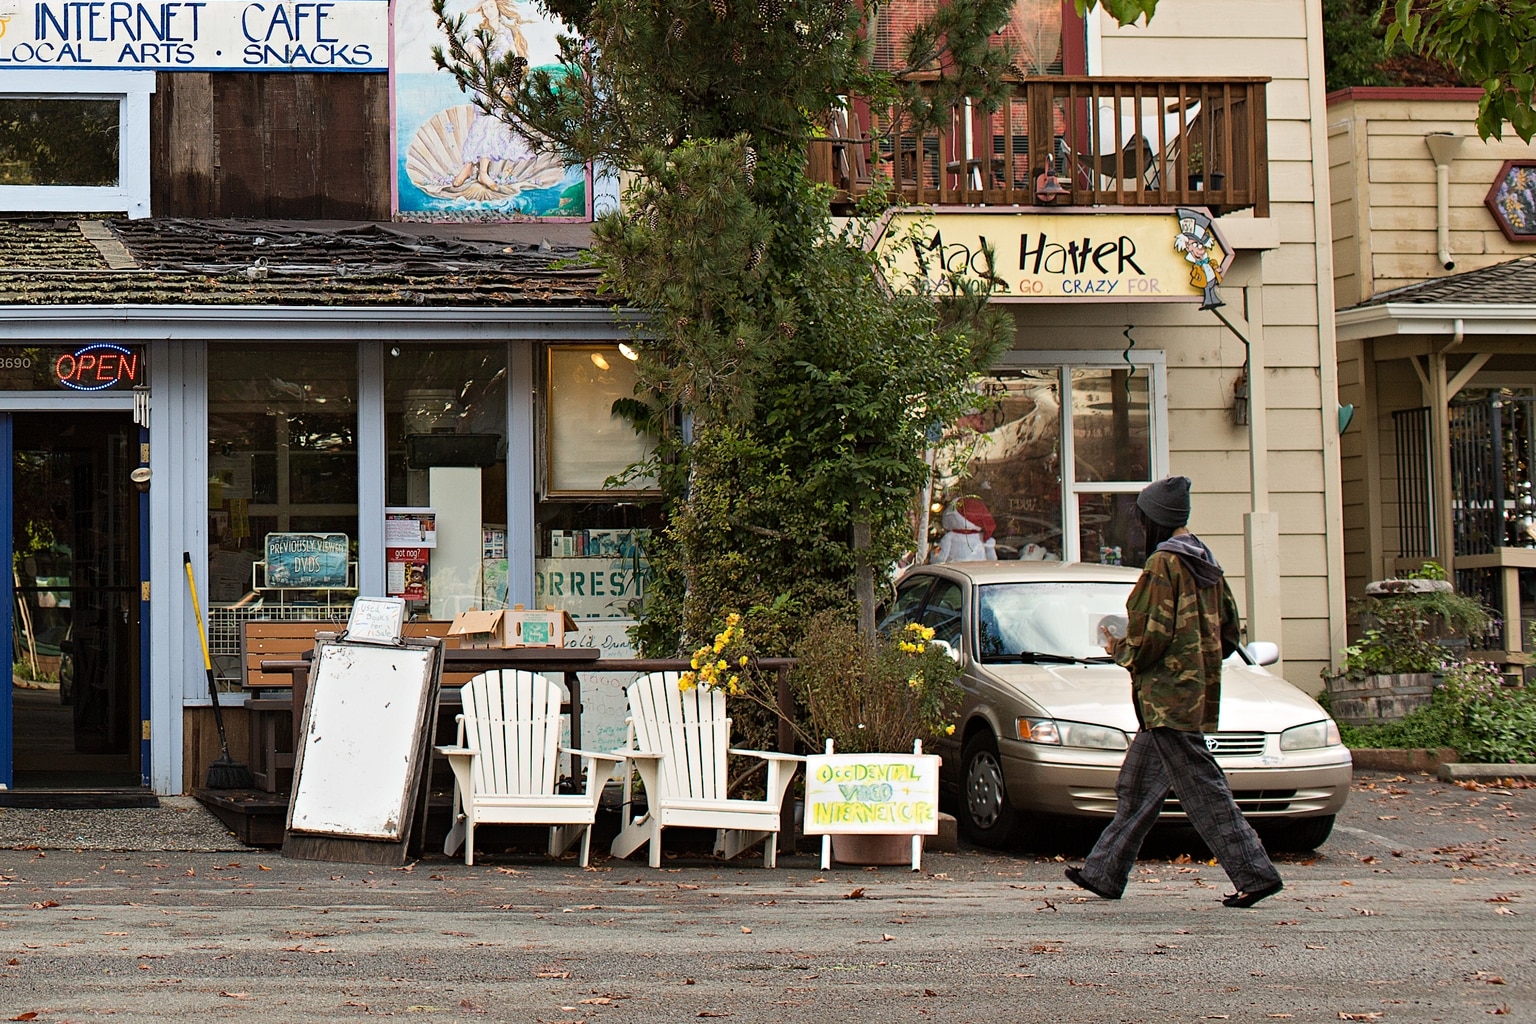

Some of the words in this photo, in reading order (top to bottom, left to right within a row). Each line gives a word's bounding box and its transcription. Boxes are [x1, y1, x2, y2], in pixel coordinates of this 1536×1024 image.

[35, 2, 206, 42] INTERNET
[242, 2, 339, 43] CAFE
[118, 43, 195, 64] ARTS
[243, 44, 373, 66] SNACKS
[1019, 280, 1043, 294] GO
[1062, 280, 1119, 294] CRAZY
[1127, 279, 1161, 294] FOR
[56, 354, 137, 380] OPEN
[269, 540, 315, 555] PREVIOUSLY
[394, 549, 405, 559] got
[406, 548, 421, 560] nog?
[294, 556, 321, 573] DVDS
[816, 763, 922, 783] OCCIDENTAL
[838, 782, 893, 802] VIDEO
[813, 802, 897, 824] INTERNET
